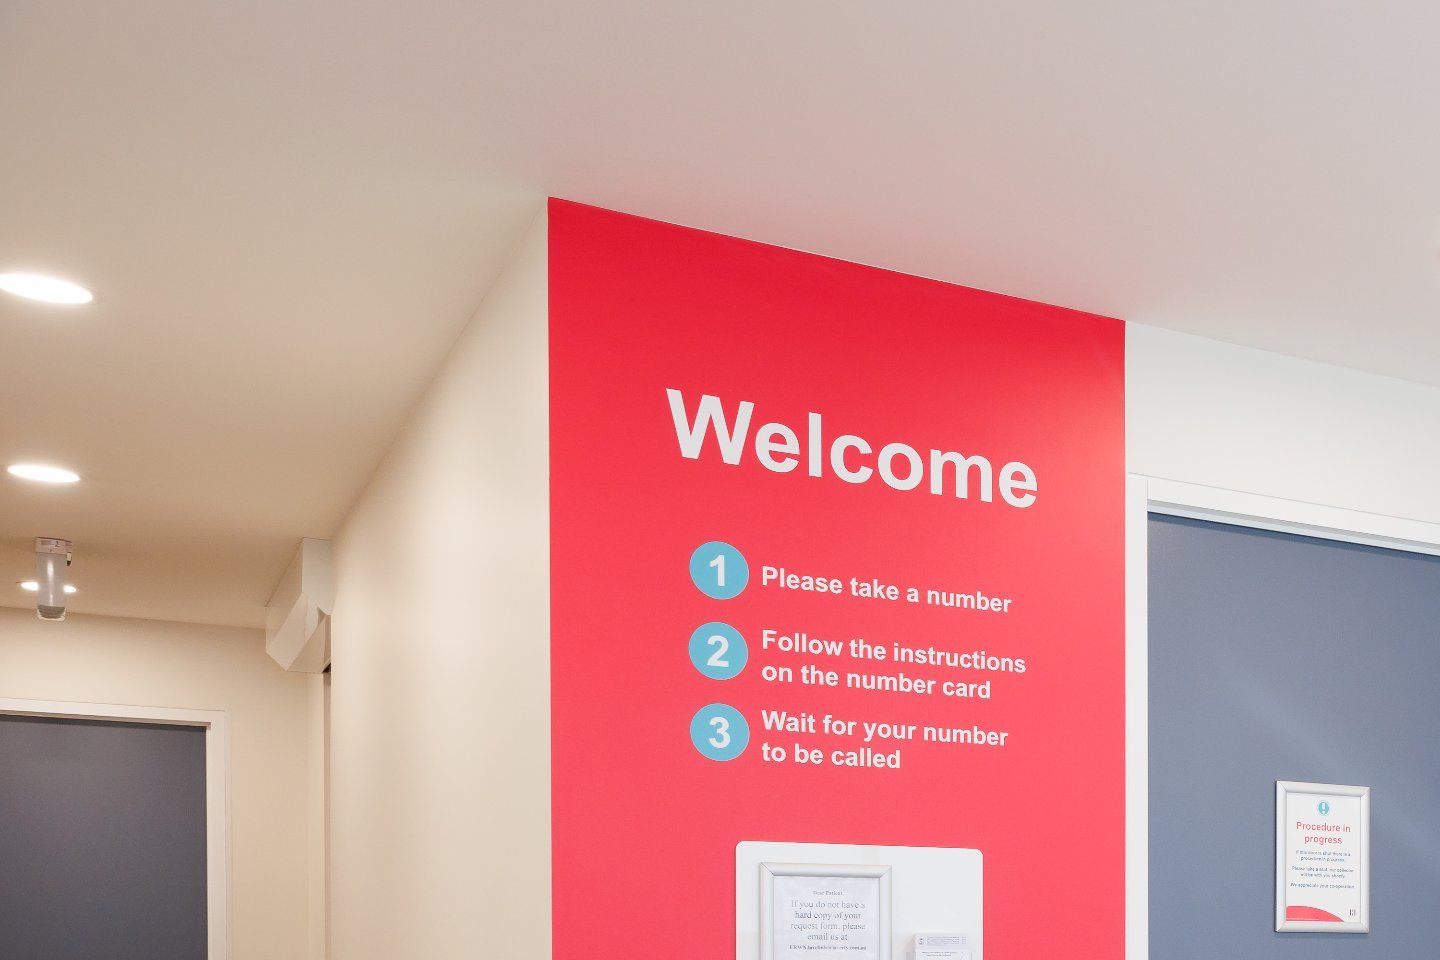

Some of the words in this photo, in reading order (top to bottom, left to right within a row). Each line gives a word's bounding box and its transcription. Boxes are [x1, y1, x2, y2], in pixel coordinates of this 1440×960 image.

[666, 387, 1038, 508] Welcome
[709, 554, 726, 586] 1
[762, 566, 843, 594] Please
[850, 577, 899, 600] take
[906, 587, 919, 603] a
[927, 589, 1012, 613] number
[706, 635, 730, 668] 2
[762, 629, 843, 655] Follow
[850, 638, 886, 660] the
[893, 642, 1026, 673] instructions
[761, 665, 792, 683] on
[801, 664, 839, 686] the
[847, 672, 936, 695] number
[942, 680, 991, 699] card
[708, 716, 731, 749] 3
[761, 709, 816, 733] Wait
[823, 714, 857, 735] for
[863, 722, 916, 742] your
[923, 725, 1008, 746] number
[761, 742, 786, 762] to
[795, 743, 824, 764] be
[831, 747, 901, 769] called
[1296, 821, 1341, 833] Procedure
[1343, 824, 1351, 833] in
[1304, 835, 1343, 846] progress
[791, 899, 799, 908] If
[799, 902, 814, 910] you
[794, 911, 812, 919] hard
[834, 911, 843, 919] of
[844, 913, 862, 921] your
[790, 923, 819, 931] request
[842, 922, 866, 931] please
[807, 932, 828, 941] email
